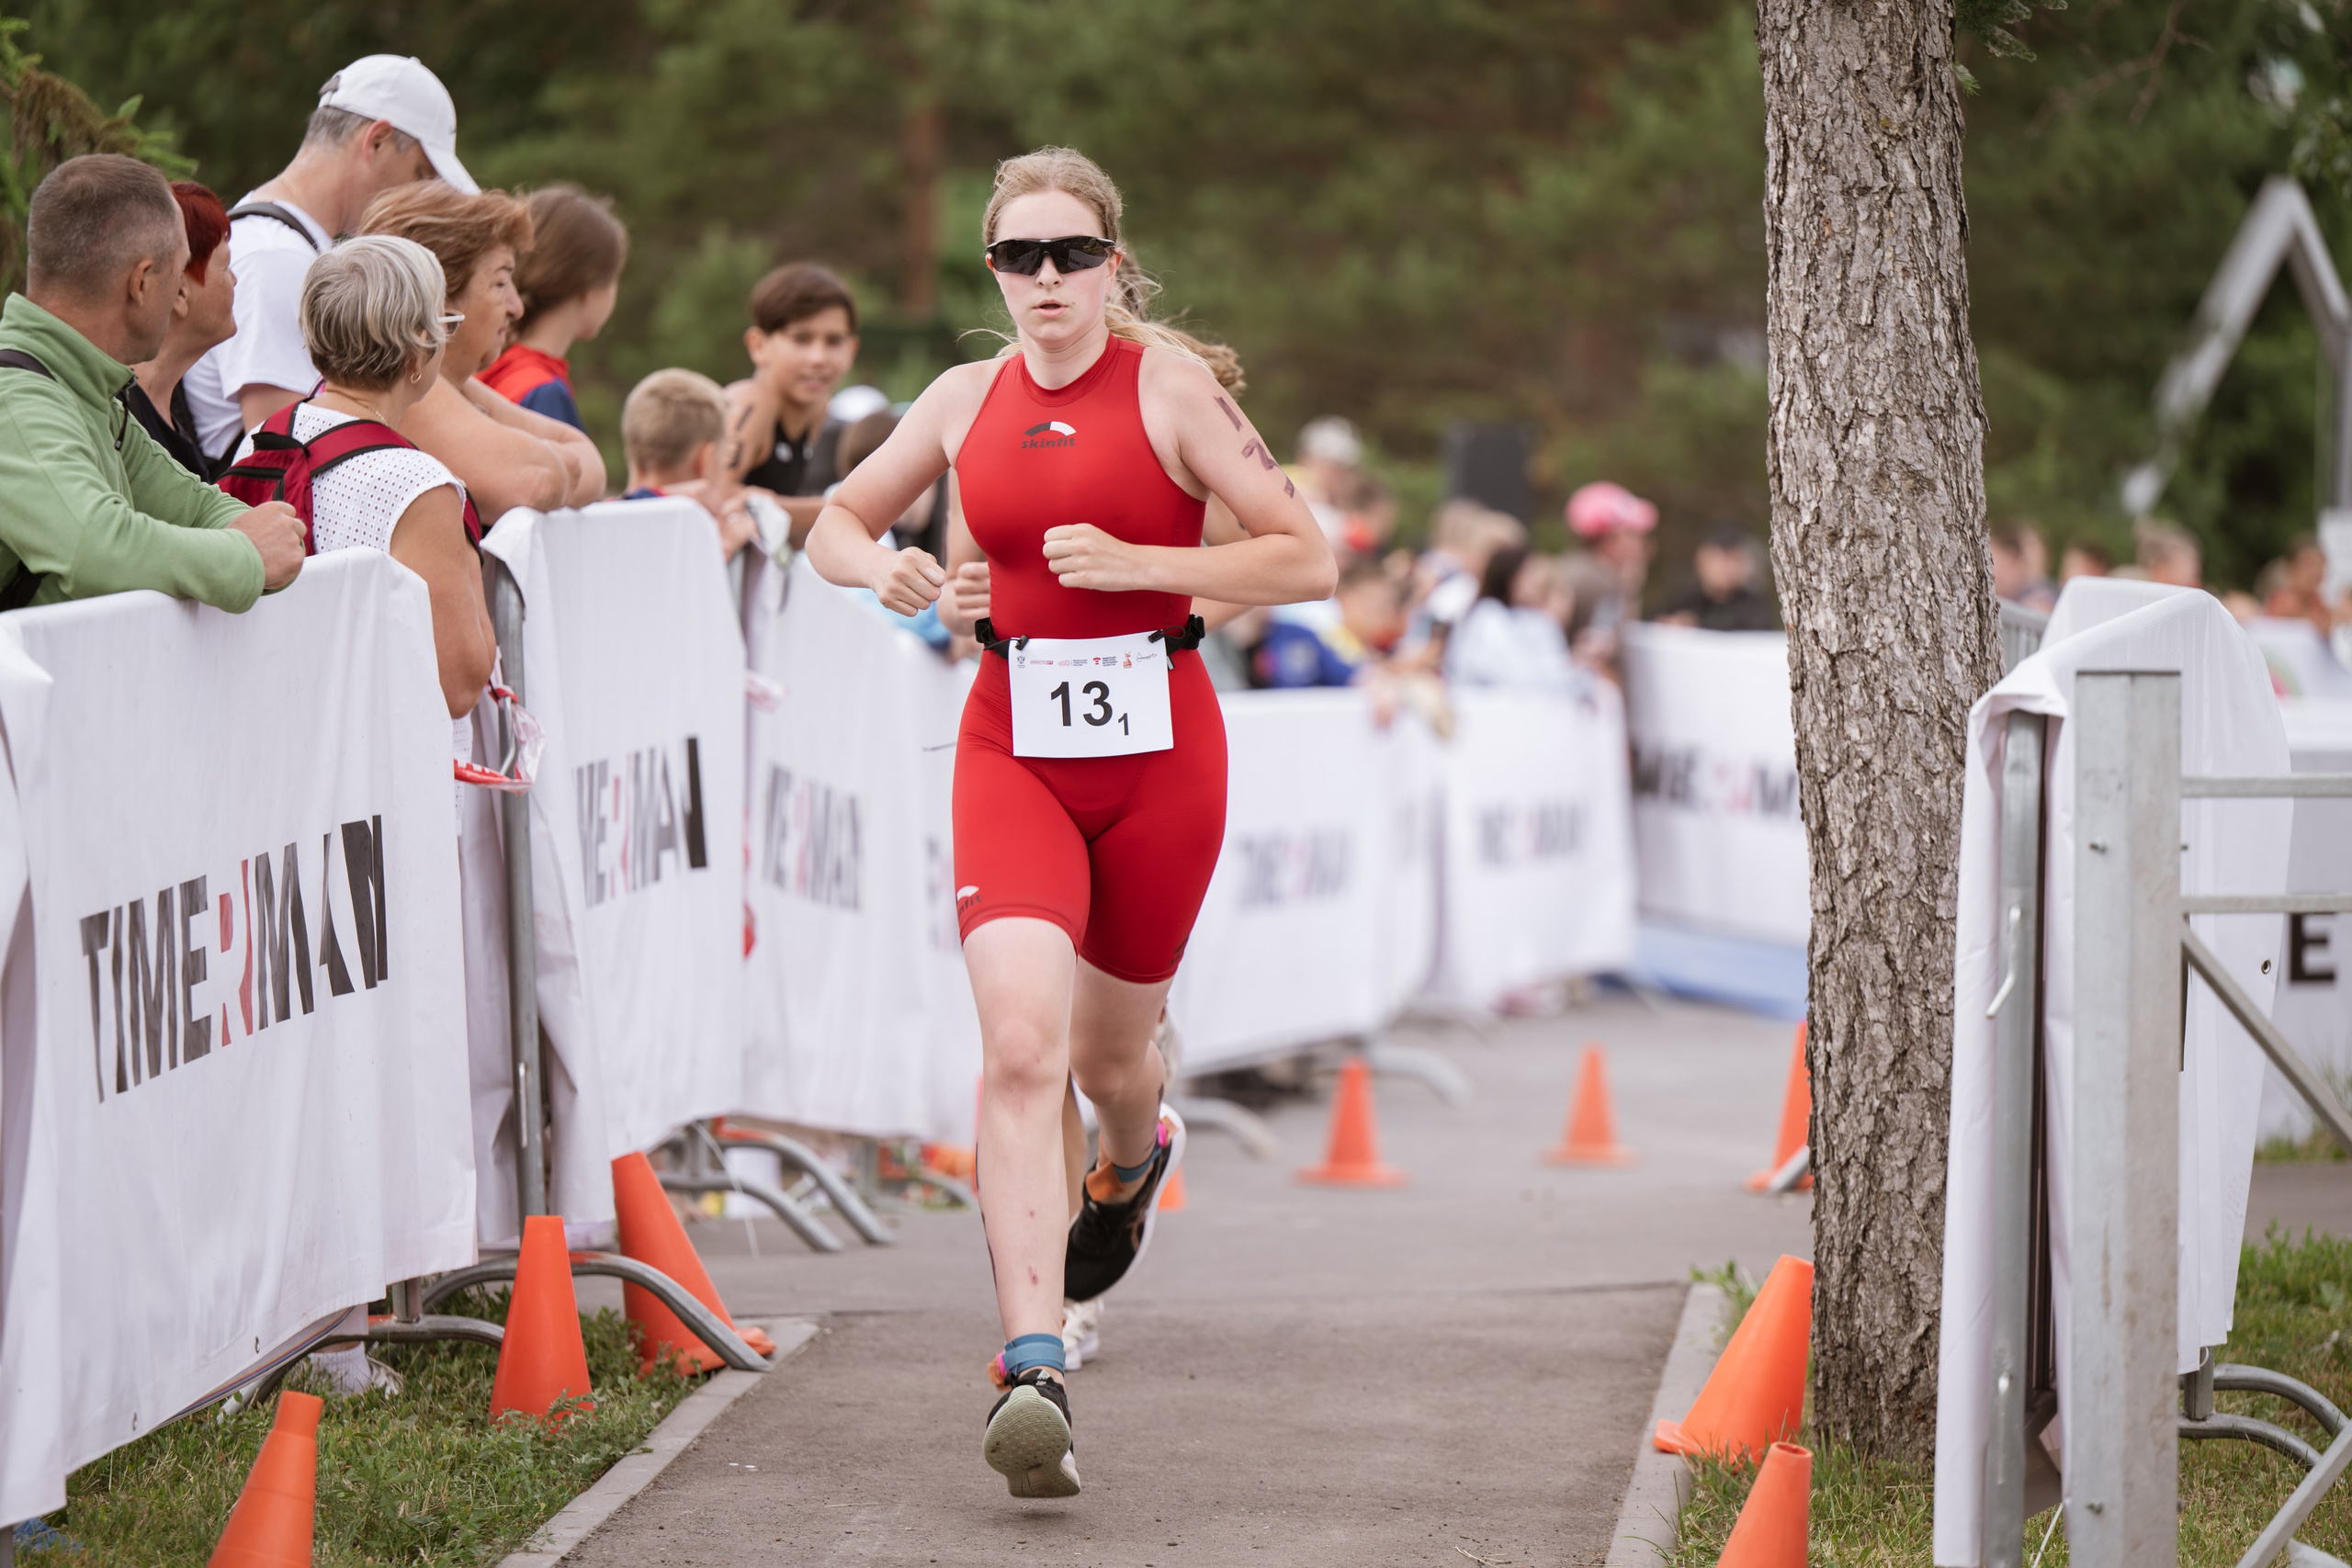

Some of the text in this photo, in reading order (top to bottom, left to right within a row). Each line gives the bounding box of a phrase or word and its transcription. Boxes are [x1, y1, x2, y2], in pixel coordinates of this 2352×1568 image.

[1021, 436, 1076, 450] skinfit
[1050, 680, 1130, 736] 13 1
